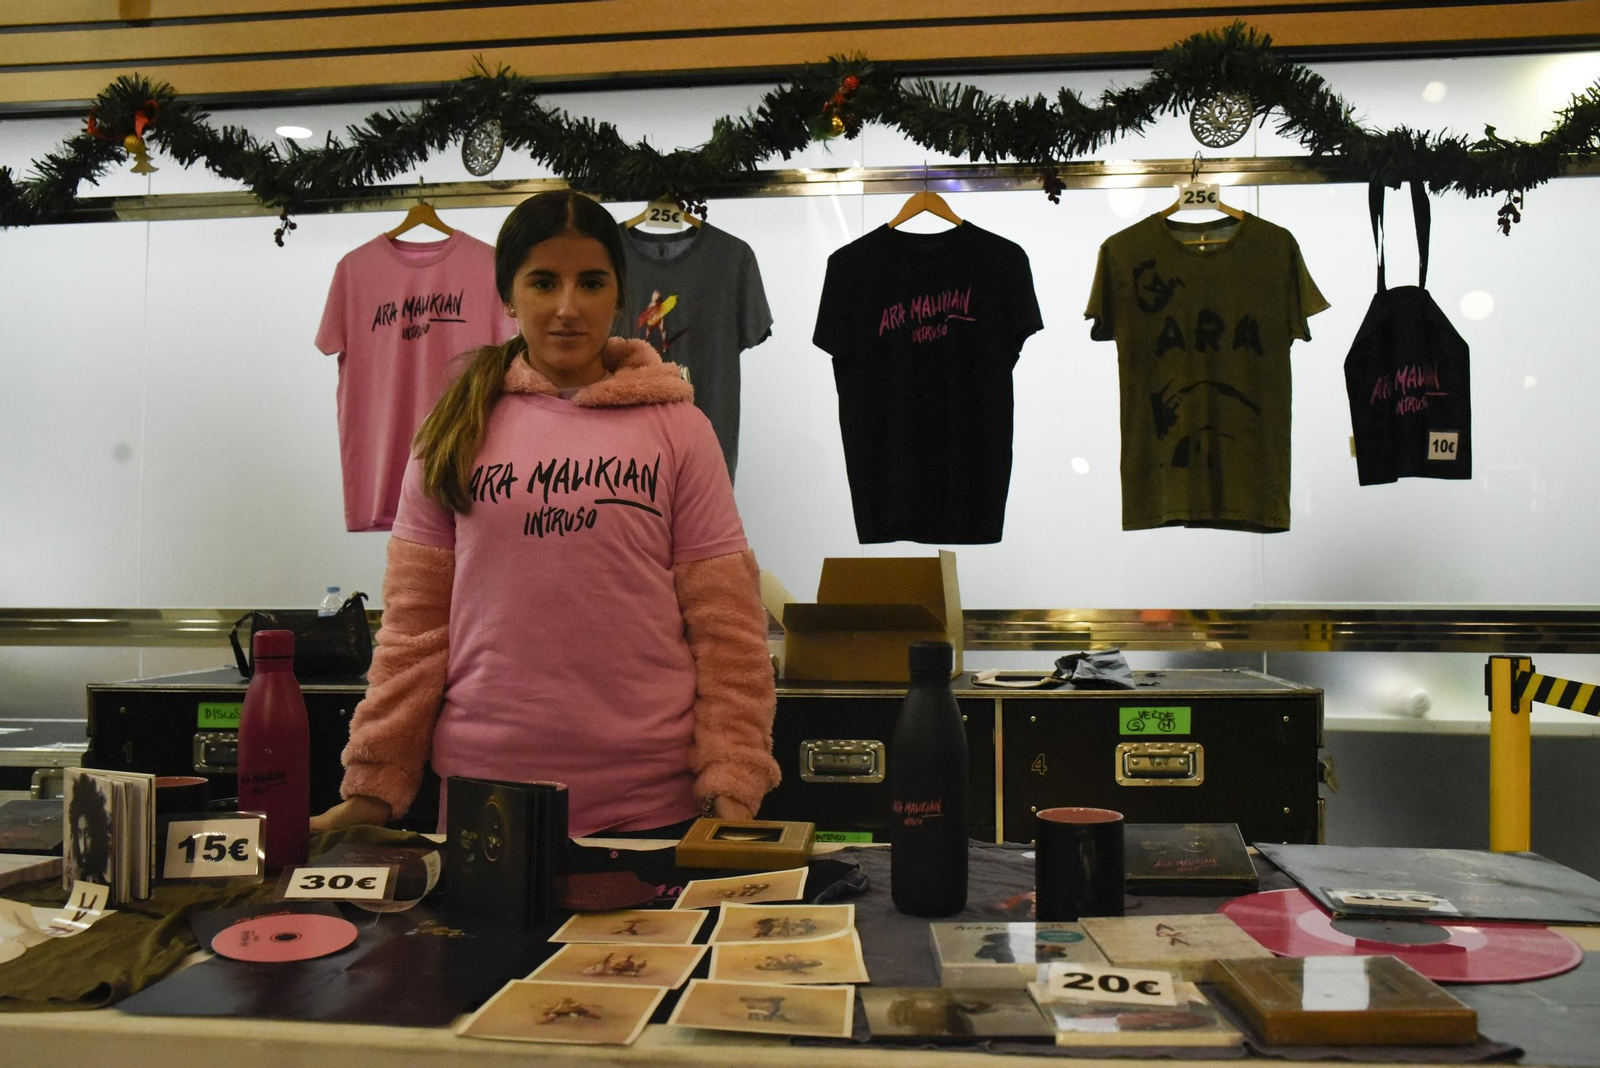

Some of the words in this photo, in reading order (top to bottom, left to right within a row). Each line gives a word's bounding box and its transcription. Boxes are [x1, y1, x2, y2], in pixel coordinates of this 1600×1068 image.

[1183, 190, 1216, 205] 25€
[649, 208, 680, 223] 25€
[372, 301, 398, 332] ARA
[402, 287, 464, 323] MALIKIAN
[879, 302, 906, 336] ARA
[1154, 309, 1265, 357] ARA
[1370, 375, 1392, 405] AR
[1432, 439, 1455, 453] 10€
[469, 462, 518, 504] ARA
[526, 453, 660, 504] MALIKIAN
[523, 505, 598, 538] INTRUSO
[1138, 710, 1175, 721] VERDE
[1031, 753, 1048, 775] 4
[904, 799, 942, 815] MALIKIAN
[178, 834, 249, 863] 15€
[299, 875, 377, 890] 30€
[1063, 972, 1161, 996] 20€
